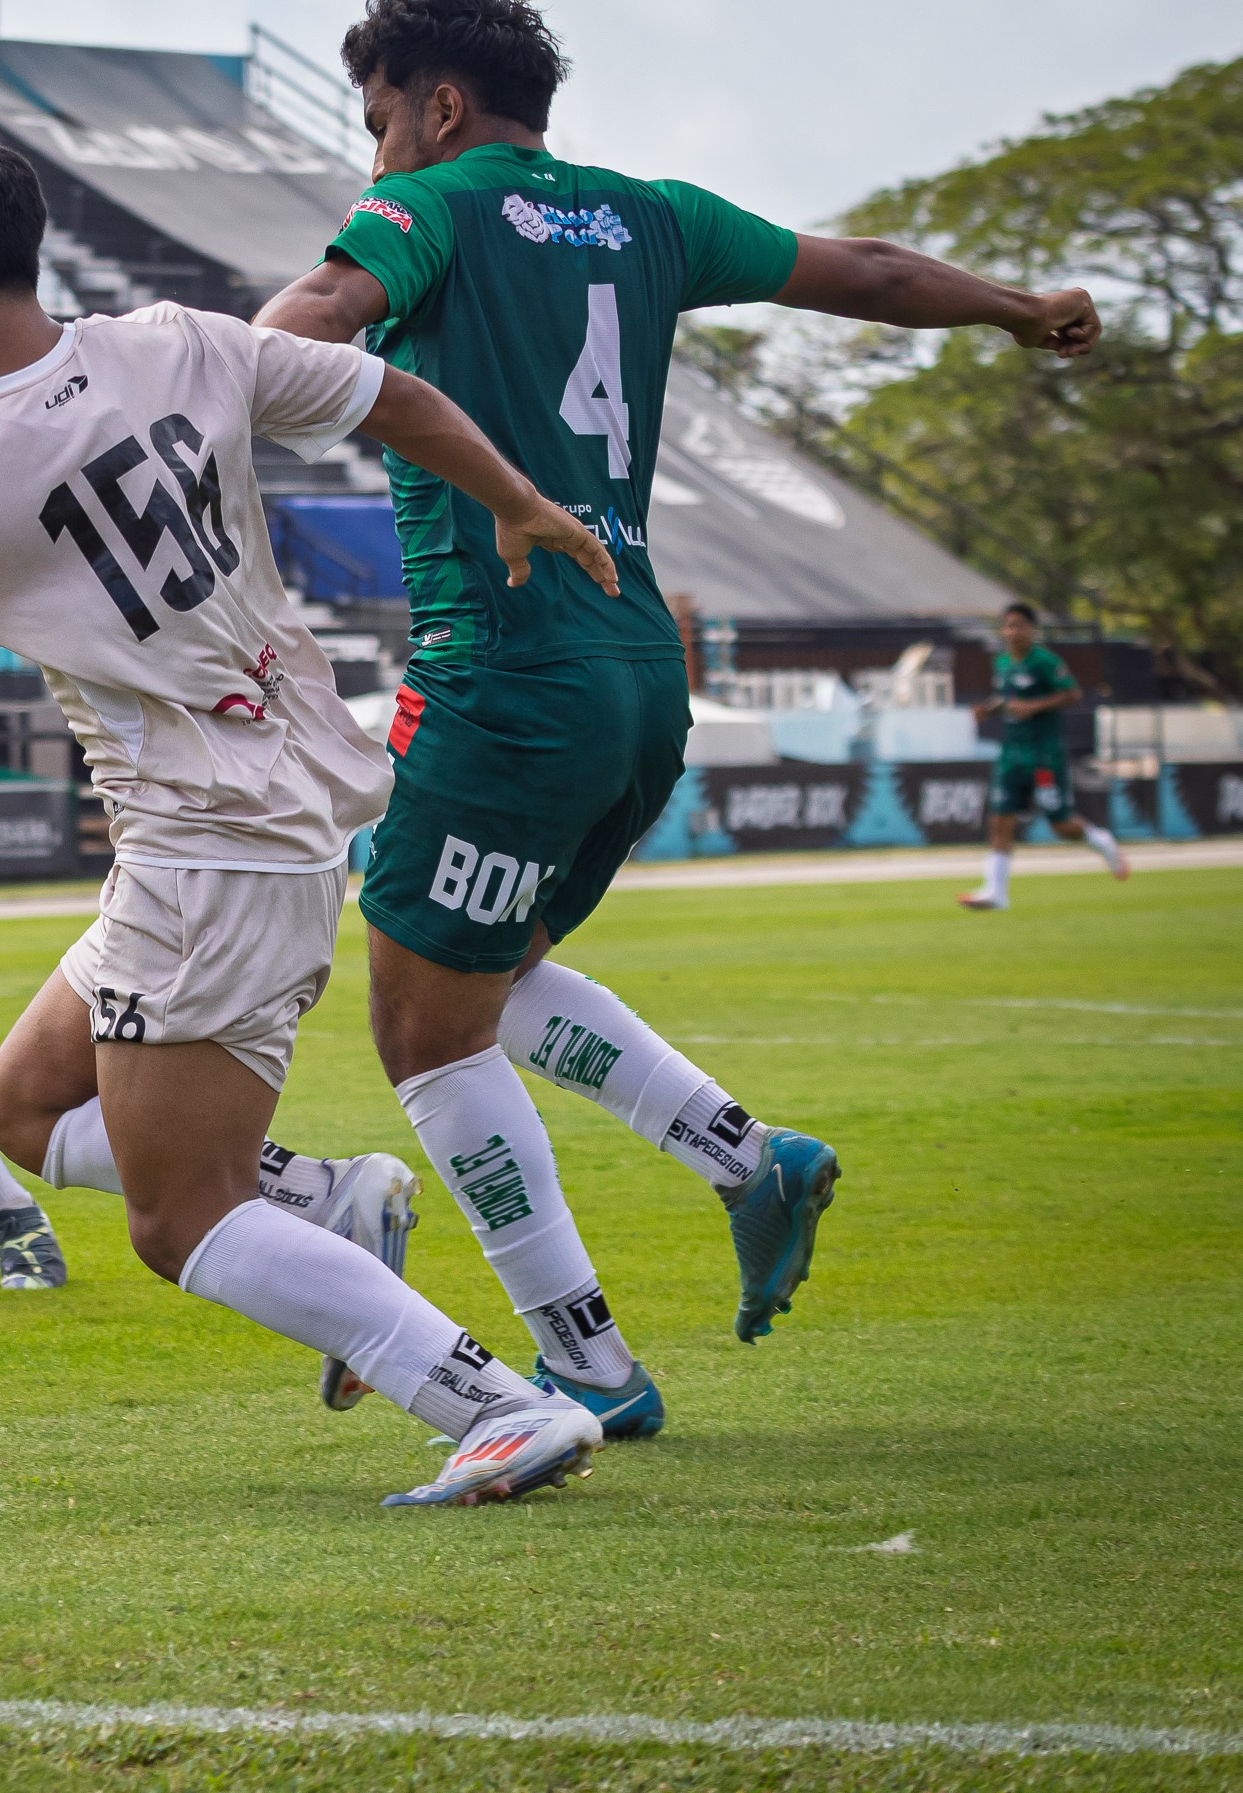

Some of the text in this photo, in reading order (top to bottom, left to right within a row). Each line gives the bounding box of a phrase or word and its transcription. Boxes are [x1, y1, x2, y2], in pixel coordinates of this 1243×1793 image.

[559, 283, 633, 479] 4
[553, 502, 592, 517] rupo
[684, 1127, 755, 1183] TAPEDESIGN
